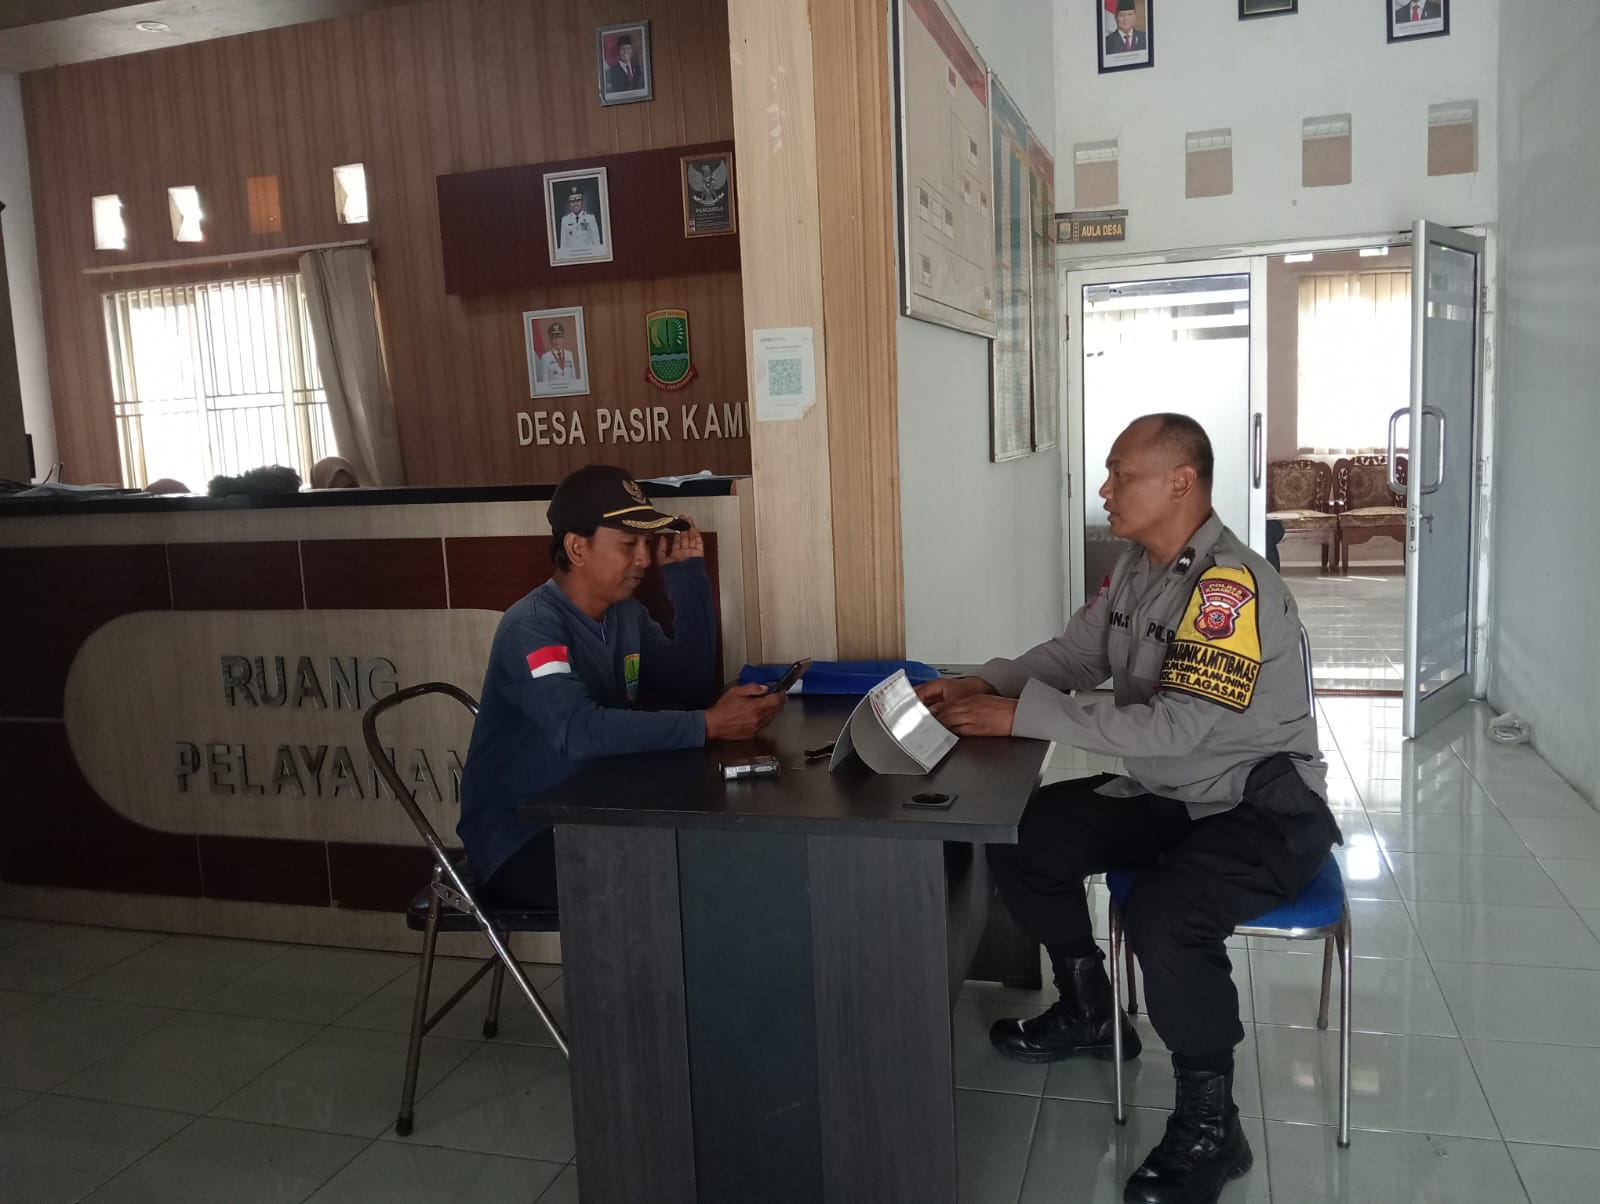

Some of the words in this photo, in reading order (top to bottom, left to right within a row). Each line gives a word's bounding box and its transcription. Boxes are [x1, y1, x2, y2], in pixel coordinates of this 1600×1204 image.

[1081, 225, 1101, 237] AULA
[1103, 223, 1122, 236] DESA
[516, 410, 587, 446] DESA
[596, 406, 672, 444] PASIR
[681, 401, 751, 440] KAM
[220, 655, 400, 710] RUANG
